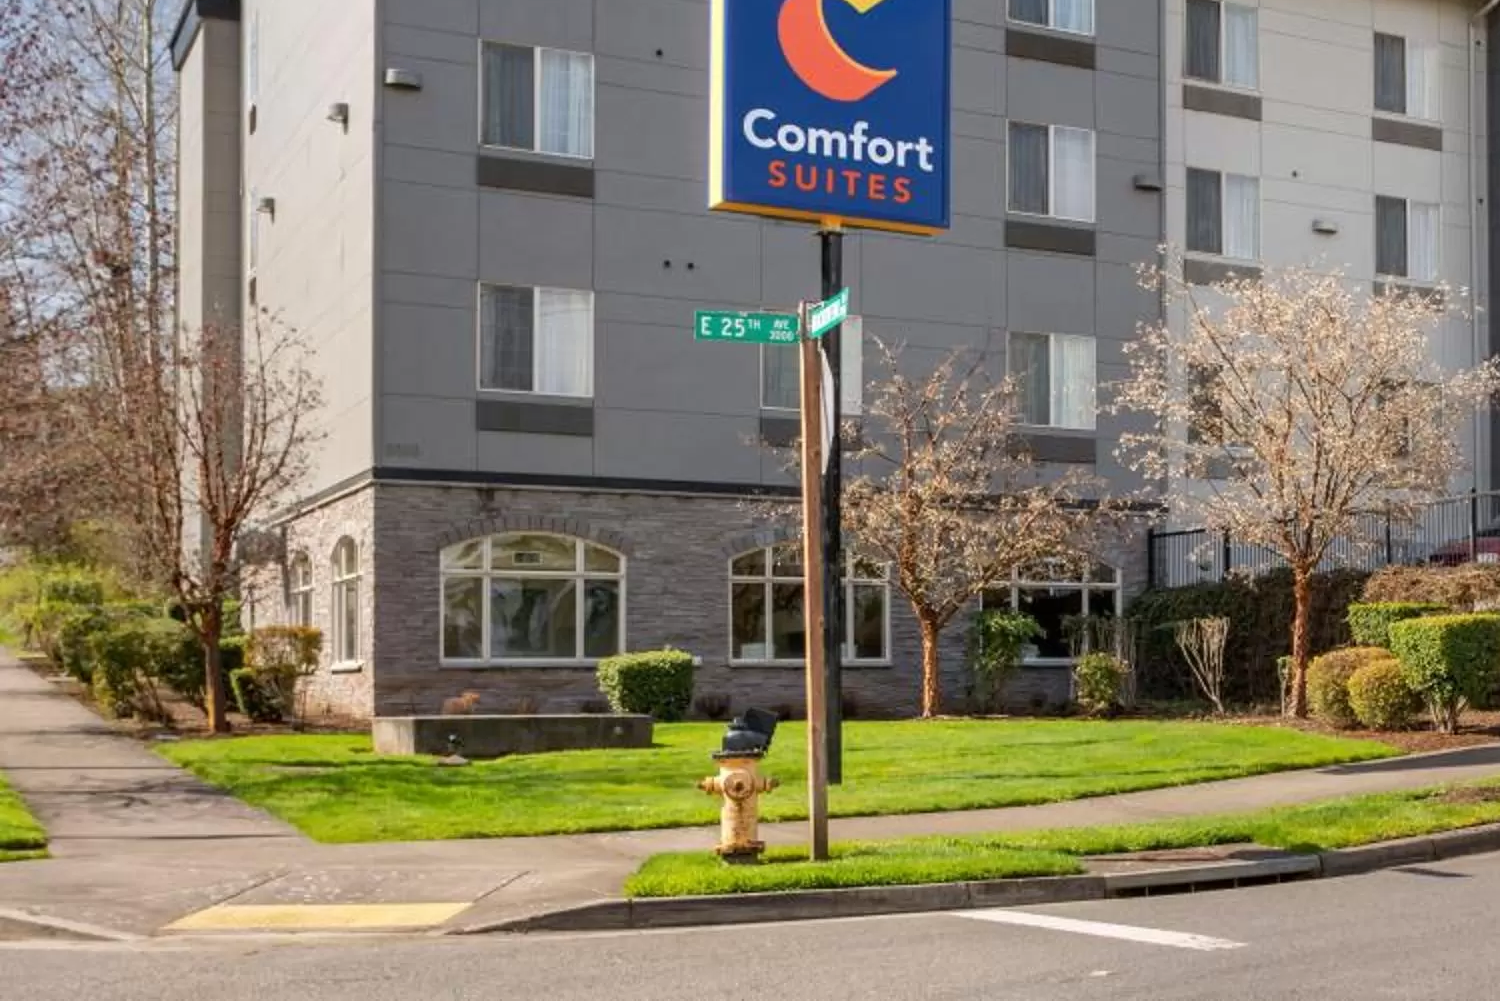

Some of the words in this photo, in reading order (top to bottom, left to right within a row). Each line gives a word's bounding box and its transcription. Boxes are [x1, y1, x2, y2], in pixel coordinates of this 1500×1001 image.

[743, 108, 934, 172] Comfort
[768, 159, 912, 203] SUITES
[701, 315, 712, 336] E
[773, 319, 790, 330] AVE
